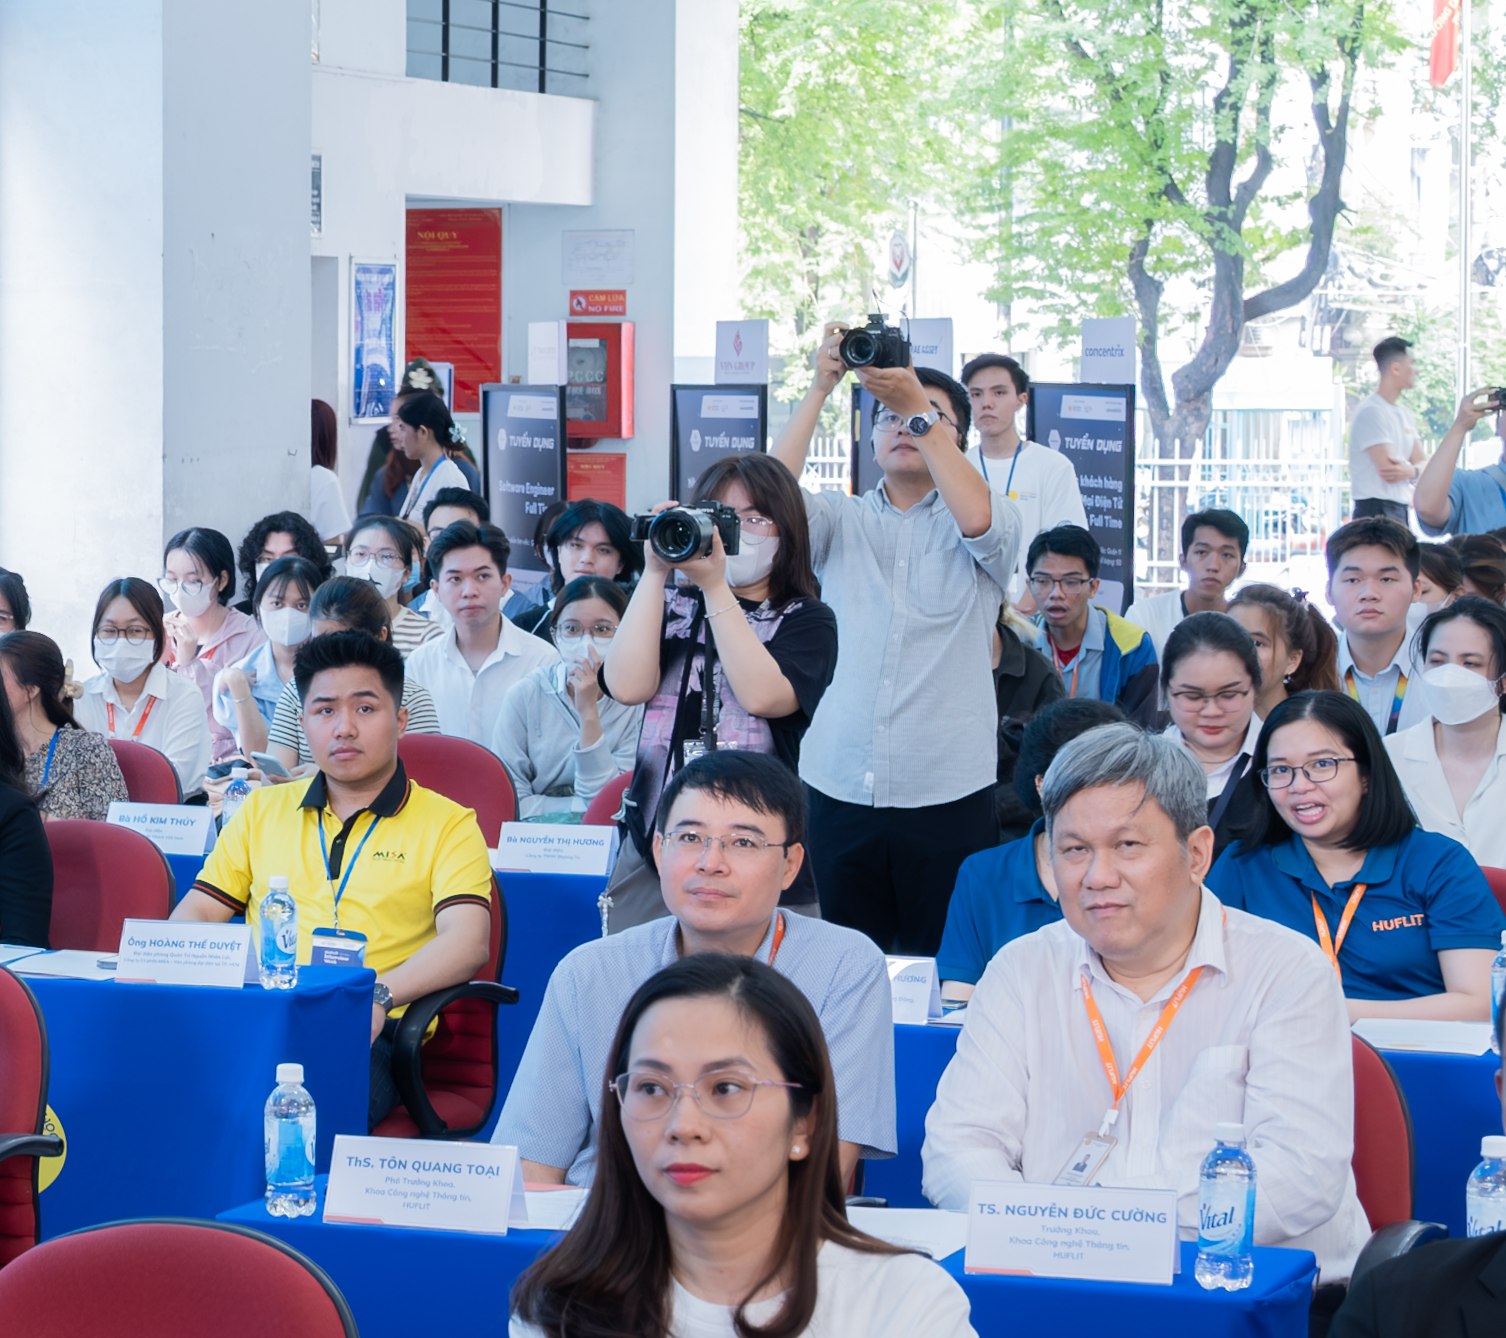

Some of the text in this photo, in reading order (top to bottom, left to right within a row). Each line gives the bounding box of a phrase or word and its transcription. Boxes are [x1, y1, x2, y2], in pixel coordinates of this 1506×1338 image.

[1084, 344, 1124, 358] concentrix
[510, 431, 532, 448] TUYỂN
[705, 431, 755, 451] TUYỂN DỤNG
[1065, 433, 1122, 455] TUYỂN DỤNG
[499, 480, 555, 497] Software Engineer
[1080, 475, 1123, 492] khách hàng
[1089, 514, 1123, 529] Full Time
[133, 815, 196, 827] HỒ KIM THÚY
[520, 835, 554, 844] NGUYỄN
[558, 838, 571, 846] THỊ
[573, 838, 605, 846] HƯƠNG
[1371, 913, 1424, 933] HUFLIT
[128, 936, 242, 952] Ông HOÀNG THẾ DUYỆT
[347, 1156, 500, 1179] ThS. TÔN QUANG TOẠI
[403, 1176, 431, 1188] Trưởng
[977, 1202, 1167, 1223] TS. NGUYỄN ĐỨC CƯỜNG
[1041, 1225, 1100, 1236] Trưởng Khoa,
[1009, 1236, 1113, 1251] Khoa Công Thông
[1053, 1251, 1085, 1260] HUFLIT
